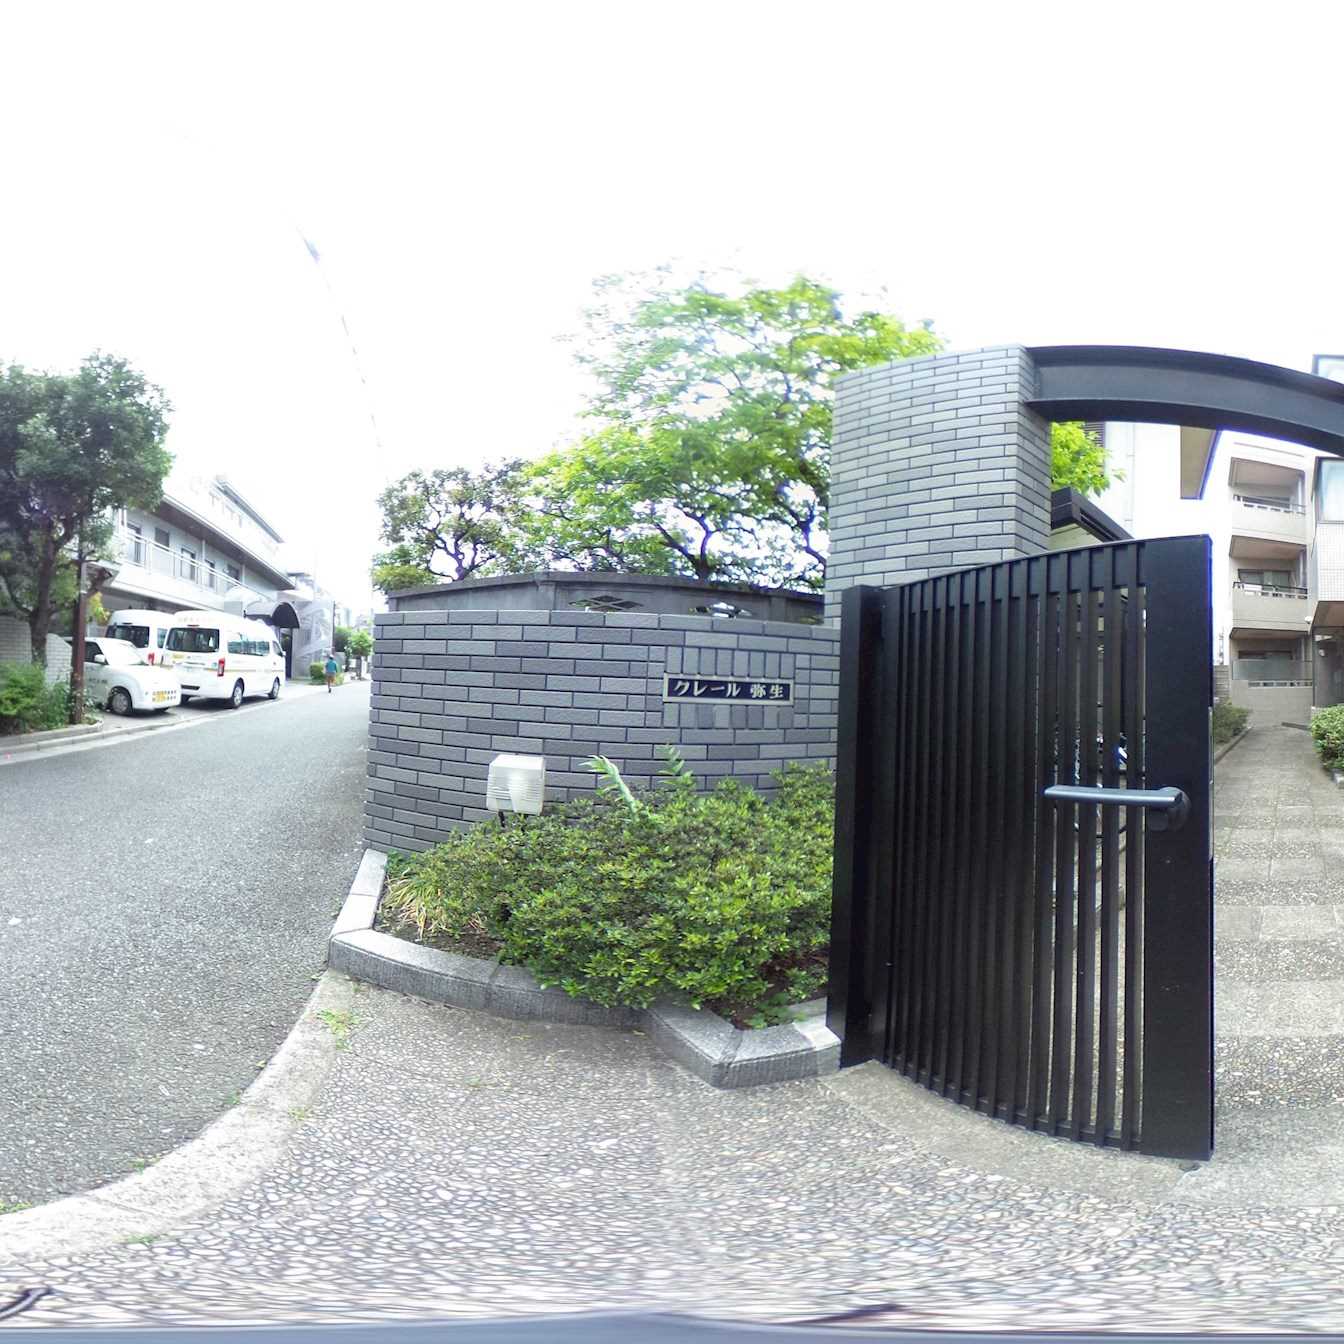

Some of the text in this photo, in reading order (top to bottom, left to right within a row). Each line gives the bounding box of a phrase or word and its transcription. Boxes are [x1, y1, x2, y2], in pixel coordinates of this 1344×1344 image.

[674, 680, 784, 699] クレール 弥生
